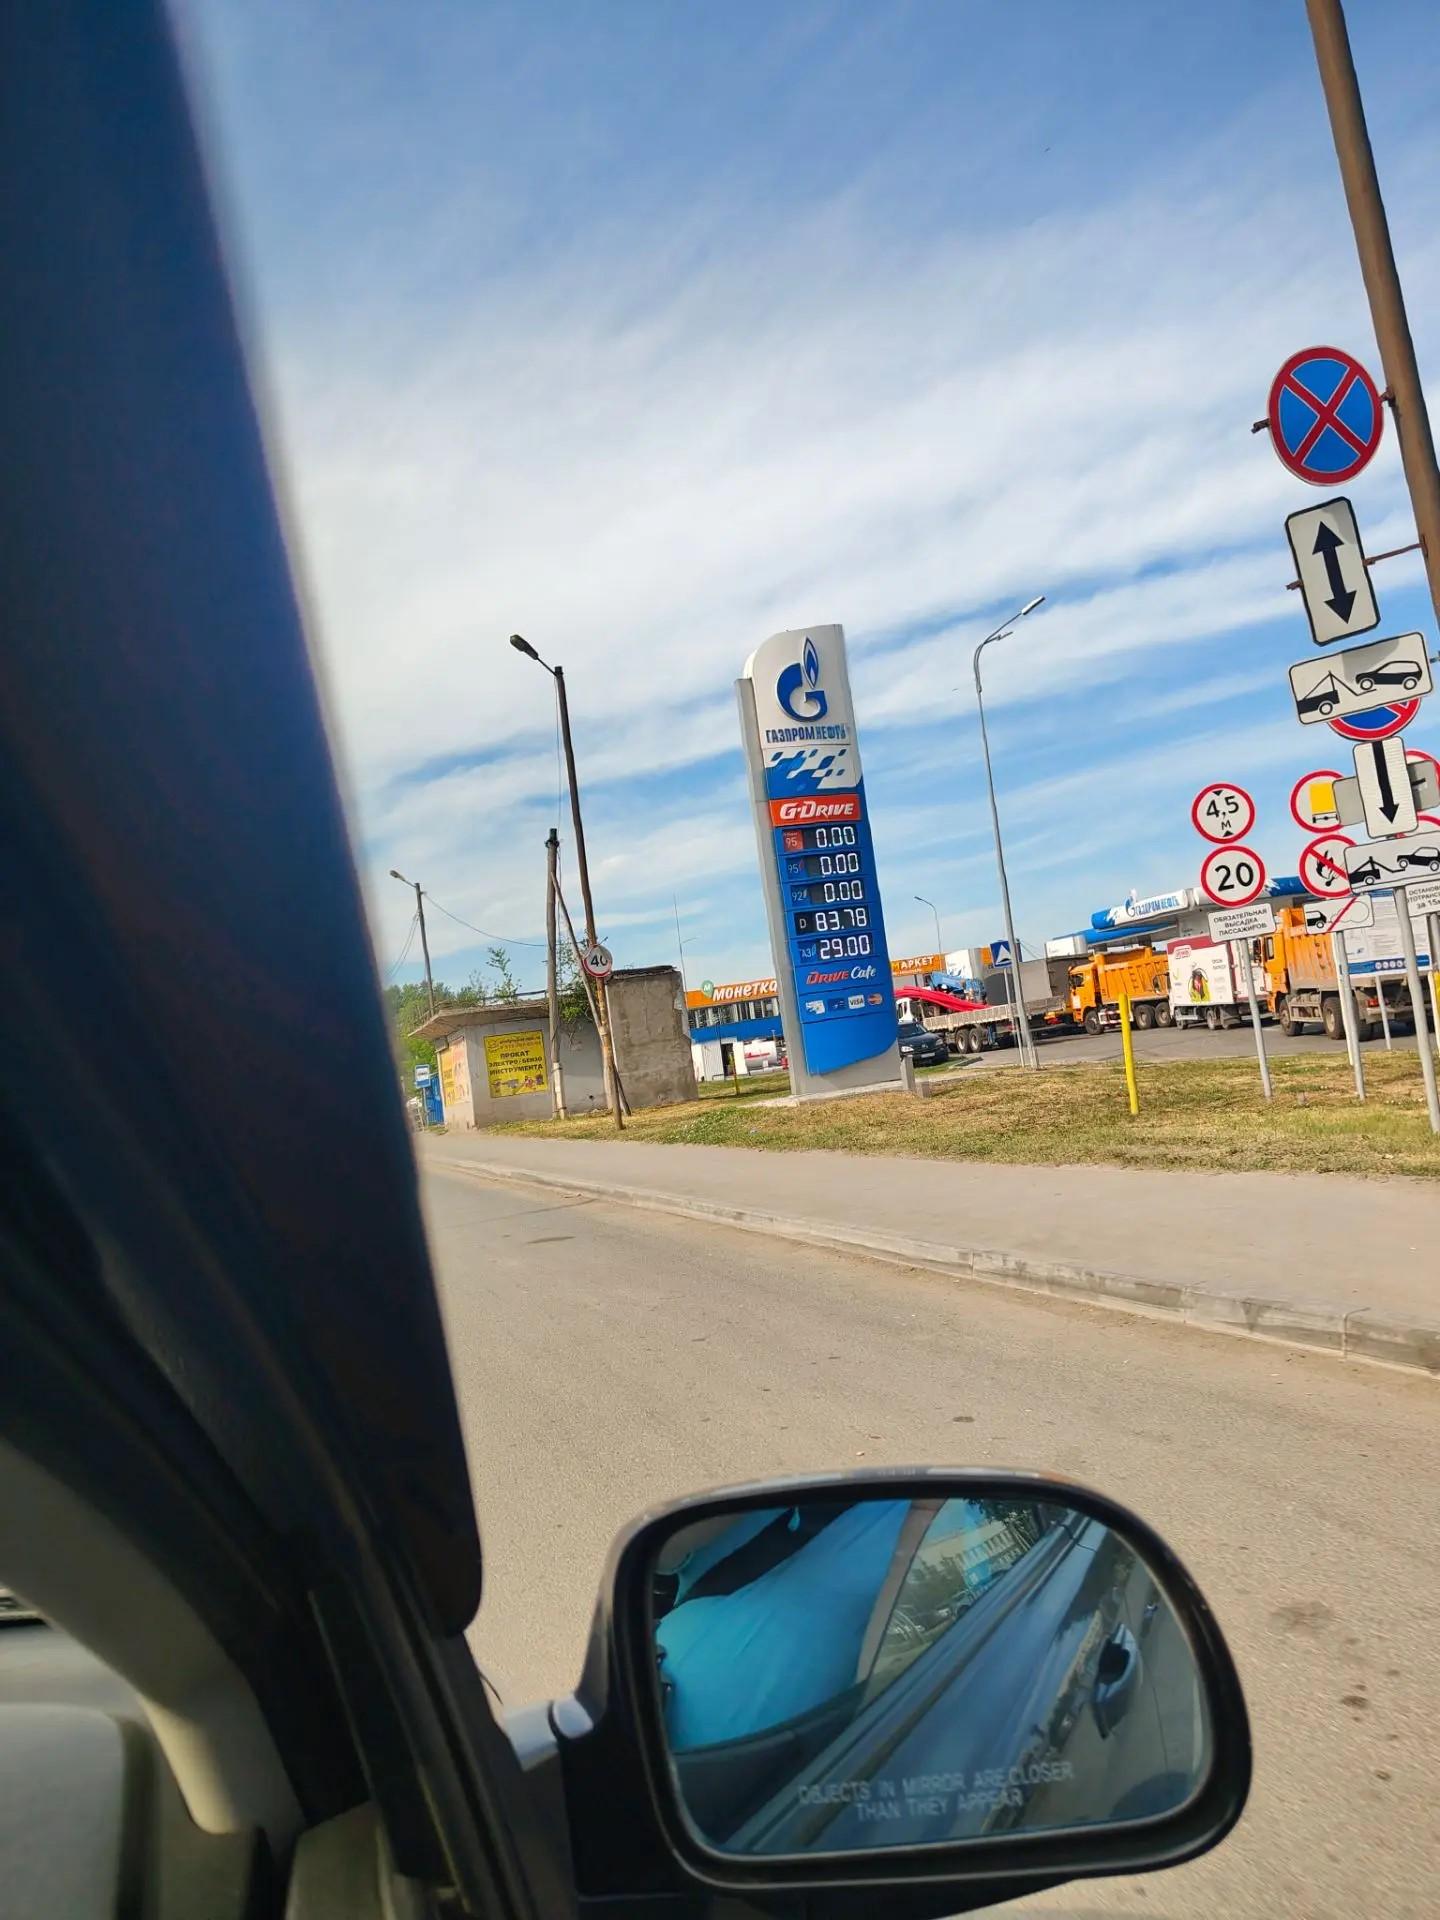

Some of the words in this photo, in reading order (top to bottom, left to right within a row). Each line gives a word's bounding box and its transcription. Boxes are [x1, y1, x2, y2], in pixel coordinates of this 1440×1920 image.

[765, 724, 847, 744] ГАЗПРОМНЕФТЬ
[1206, 796, 1239, 819] 4,5
[785, 836, 798, 848] 95
[815, 826, 855, 848] 0.00
[820, 853, 859, 875] 0.00
[1214, 862, 1254, 892] 20
[824, 880, 863, 903] 0.00
[815, 908, 867, 932] 83.78
[1213, 908, 1268, 923] ОБЯЗАТЕЛЬНАЯ
[1224, 917, 1258, 929] ВЫСАДКА
[1218, 922, 1268, 936] ПАССАЖИРОВ
[820, 935, 870, 960] 29.00
[500, 1050, 529, 1059] ПРОКАТ
[489, 1063, 543, 1075] ИНСТРУМЕНТА
[800, 1780, 872, 1804] OBJECTS
[880, 1780, 895, 1798] IN
[902, 1773, 965, 1796] MIRROR
[974, 1768, 1006, 1788] ARE
[1008, 1761, 1074, 1786] CLOSER
[857, 1801, 900, 1822] THAN
[908, 1797, 947, 1817] THEY
[958, 1789, 1024, 1812] APPEAR
